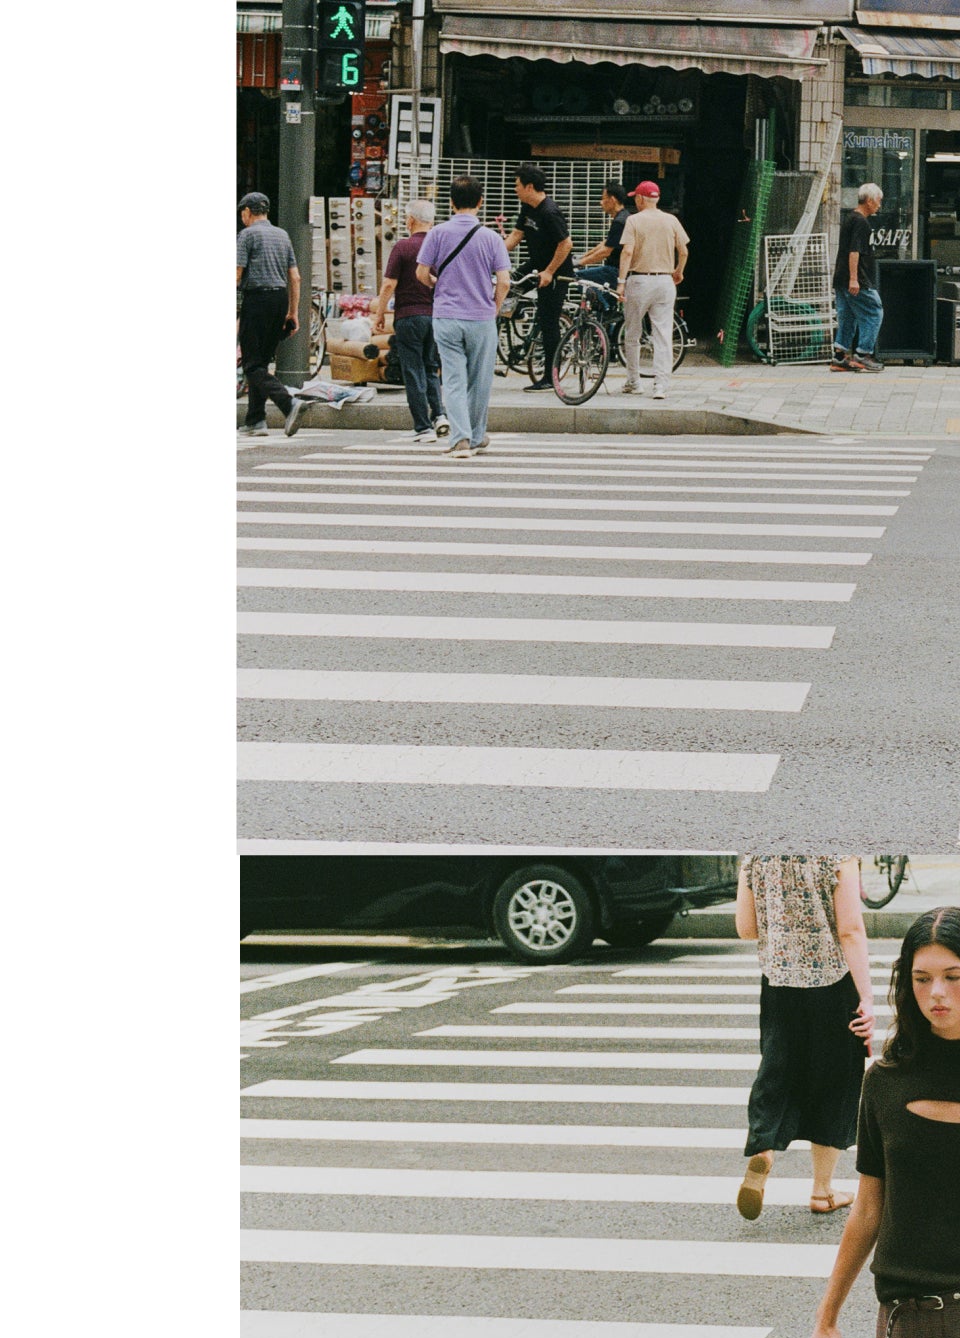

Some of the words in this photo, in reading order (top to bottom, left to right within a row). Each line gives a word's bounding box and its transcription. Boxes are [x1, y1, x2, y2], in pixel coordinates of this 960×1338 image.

[342, 53, 359, 85] 6
[843, 131, 912, 149] Kumahira
[874, 228, 912, 246] SAFE
